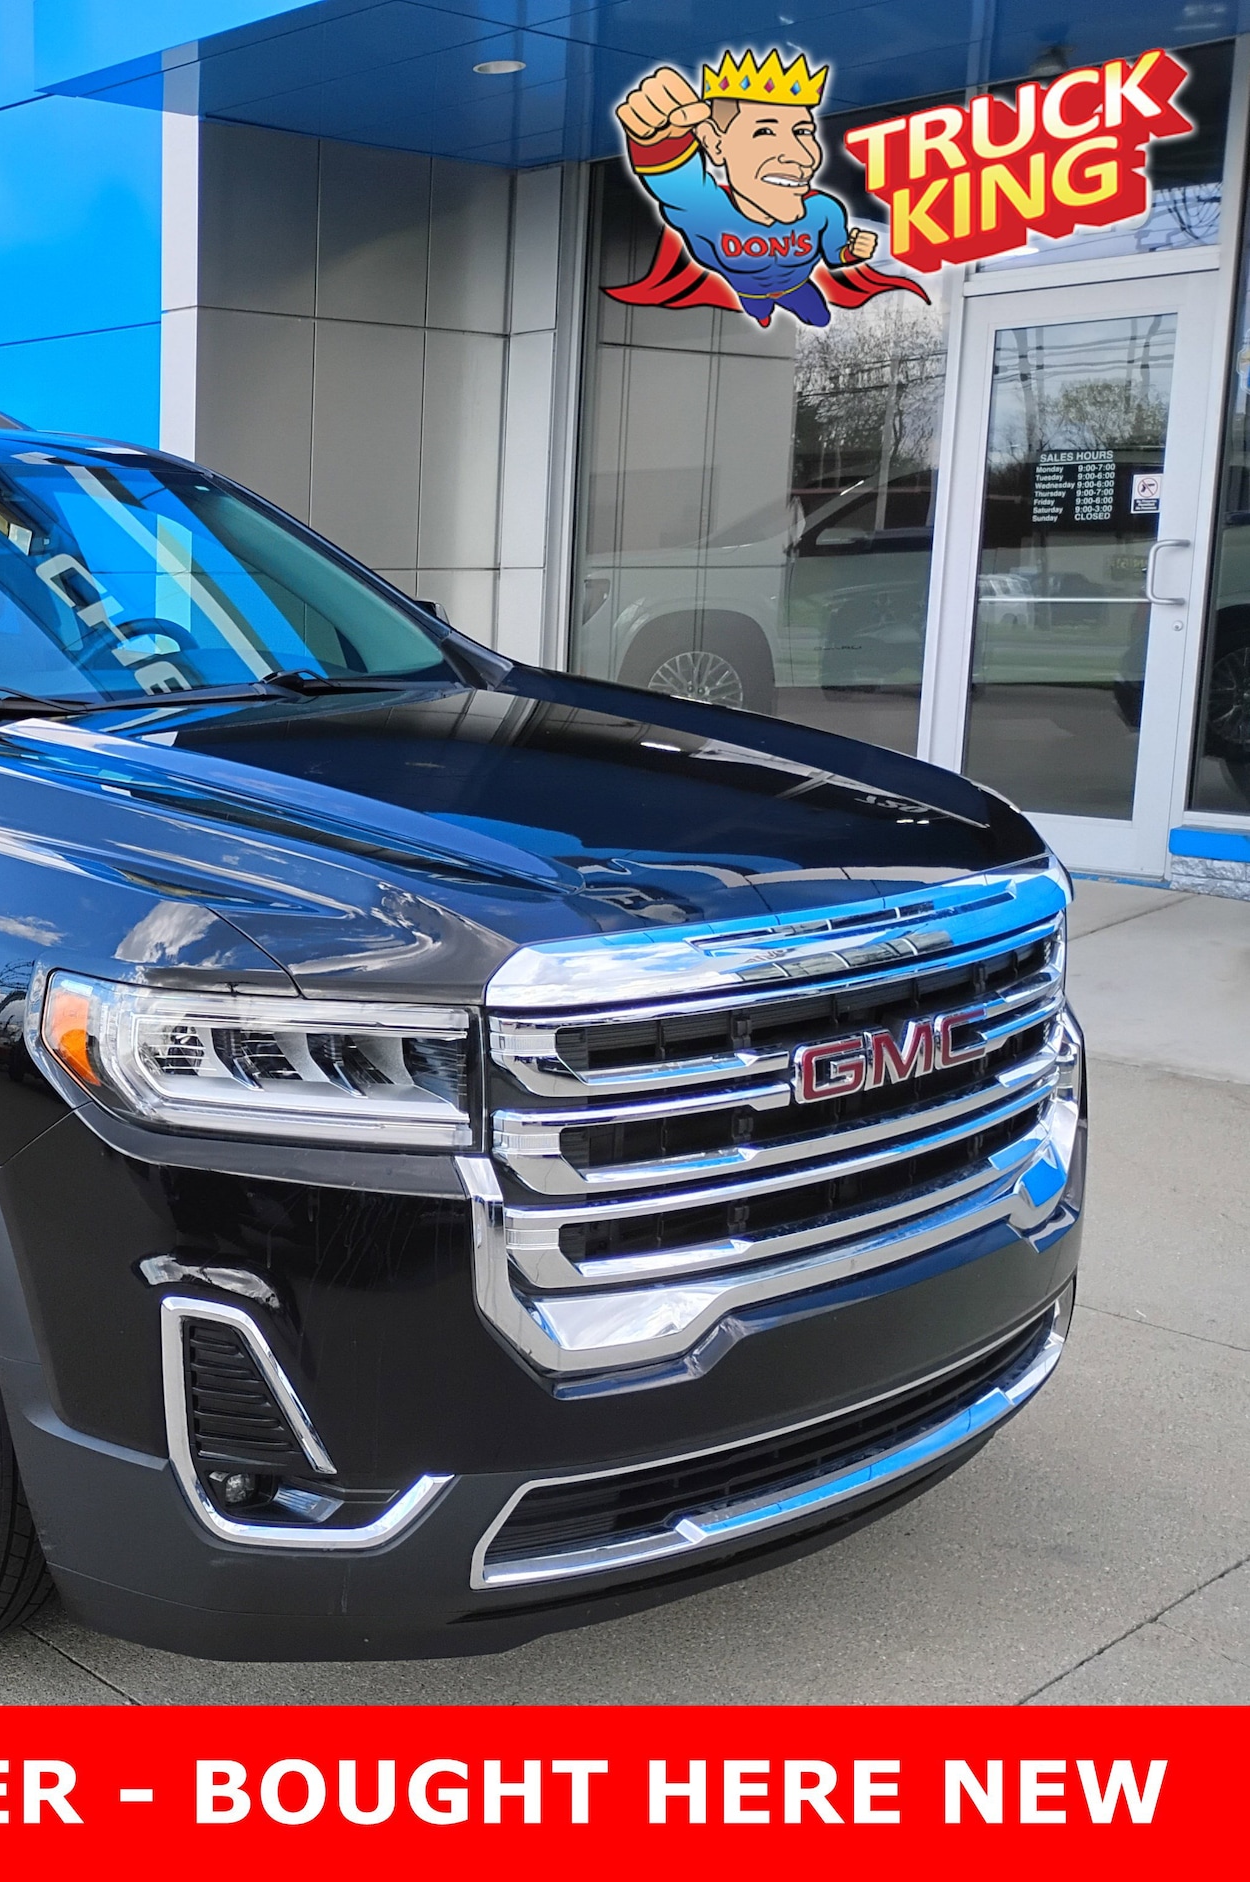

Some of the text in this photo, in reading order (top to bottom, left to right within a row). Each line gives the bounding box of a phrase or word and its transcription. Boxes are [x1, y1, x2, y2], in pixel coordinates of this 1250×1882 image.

[1040, 450, 1114, 463] SALES HOURS
[1078, 463, 1116, 472] 9:00-7:00
[1035, 474, 1064, 482] Tuesday
[1034, 488, 1114, 498] Thursday 9:00-7:00
[1074, 512, 1111, 521] CLOSED
[793, 1002, 988, 1104] GMC
